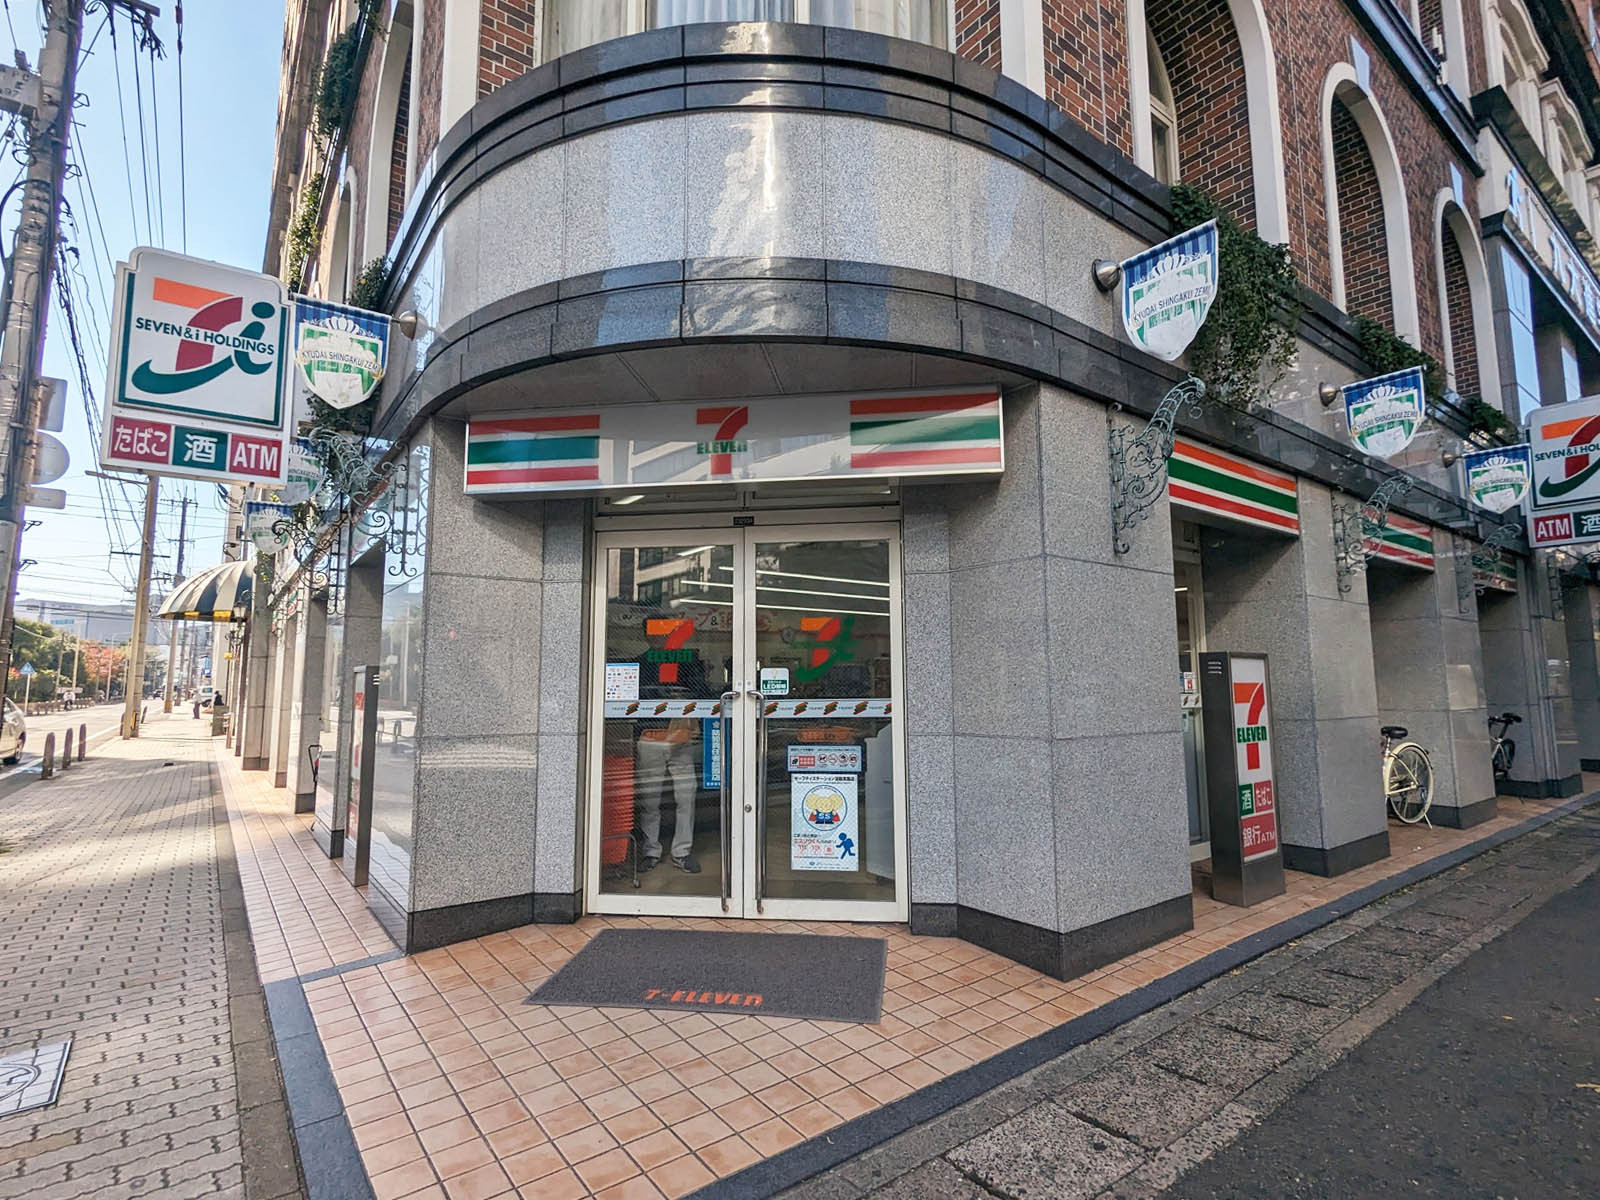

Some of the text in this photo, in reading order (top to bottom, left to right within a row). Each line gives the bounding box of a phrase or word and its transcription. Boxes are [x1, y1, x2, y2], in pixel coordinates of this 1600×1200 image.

[1132, 304, 1157, 322] KYUDAI
[1158, 290, 1194, 309] SHINGAKU
[203, 331, 275, 356] HOLDINGS
[302, 350, 380, 372] KYUDAI SHINGAKU ZEM
[114, 424, 167, 457] たばこ
[183, 432, 219, 464] 酒
[232, 441, 279, 472] ATM
[1537, 517, 1571, 539] ATM
[1241, 788, 1253, 811] 酒
[1255, 786, 1273, 808] たばこ
